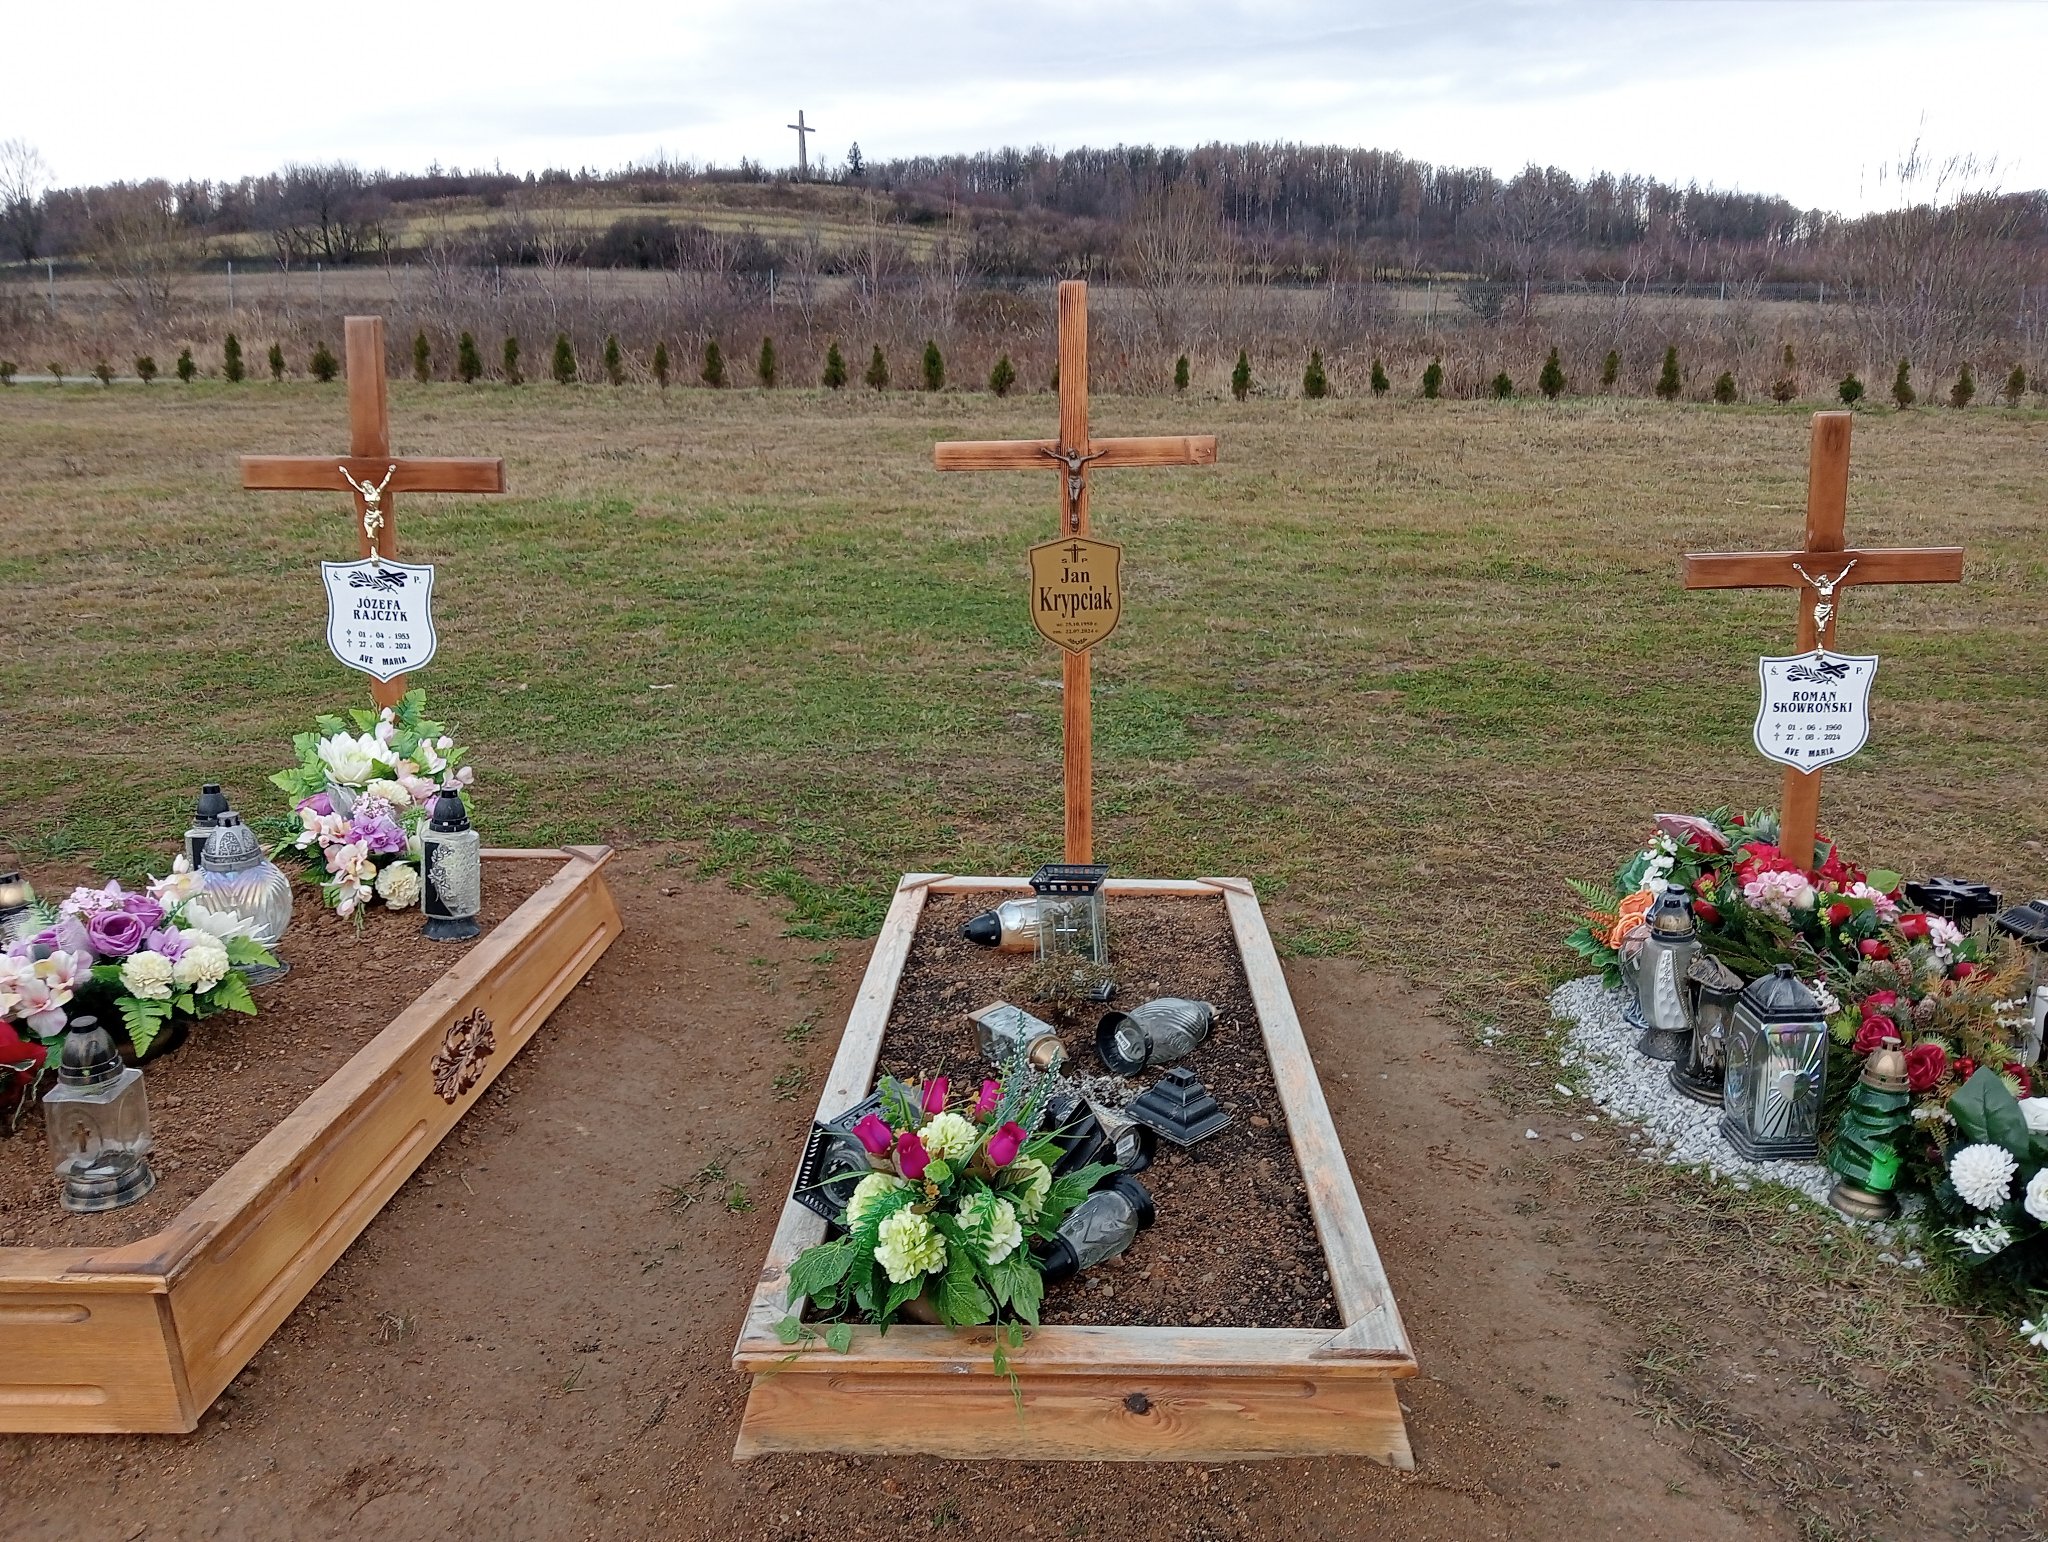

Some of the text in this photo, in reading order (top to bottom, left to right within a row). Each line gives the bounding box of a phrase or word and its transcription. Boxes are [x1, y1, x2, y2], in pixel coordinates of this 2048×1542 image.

[1061, 568, 1090, 584] Jan
[357, 596, 401, 610] JÓZEFA
[1040, 586, 1113, 618] Krypciak
[354, 610, 408, 622] RAJCZYK
[359, 654, 408, 666] AVE MARIA
[1792, 692, 1837, 702] ROMAN
[1773, 700, 1853, 713] SKOWROŃSKI
[1784, 747, 1835, 757] AVE MARIA
